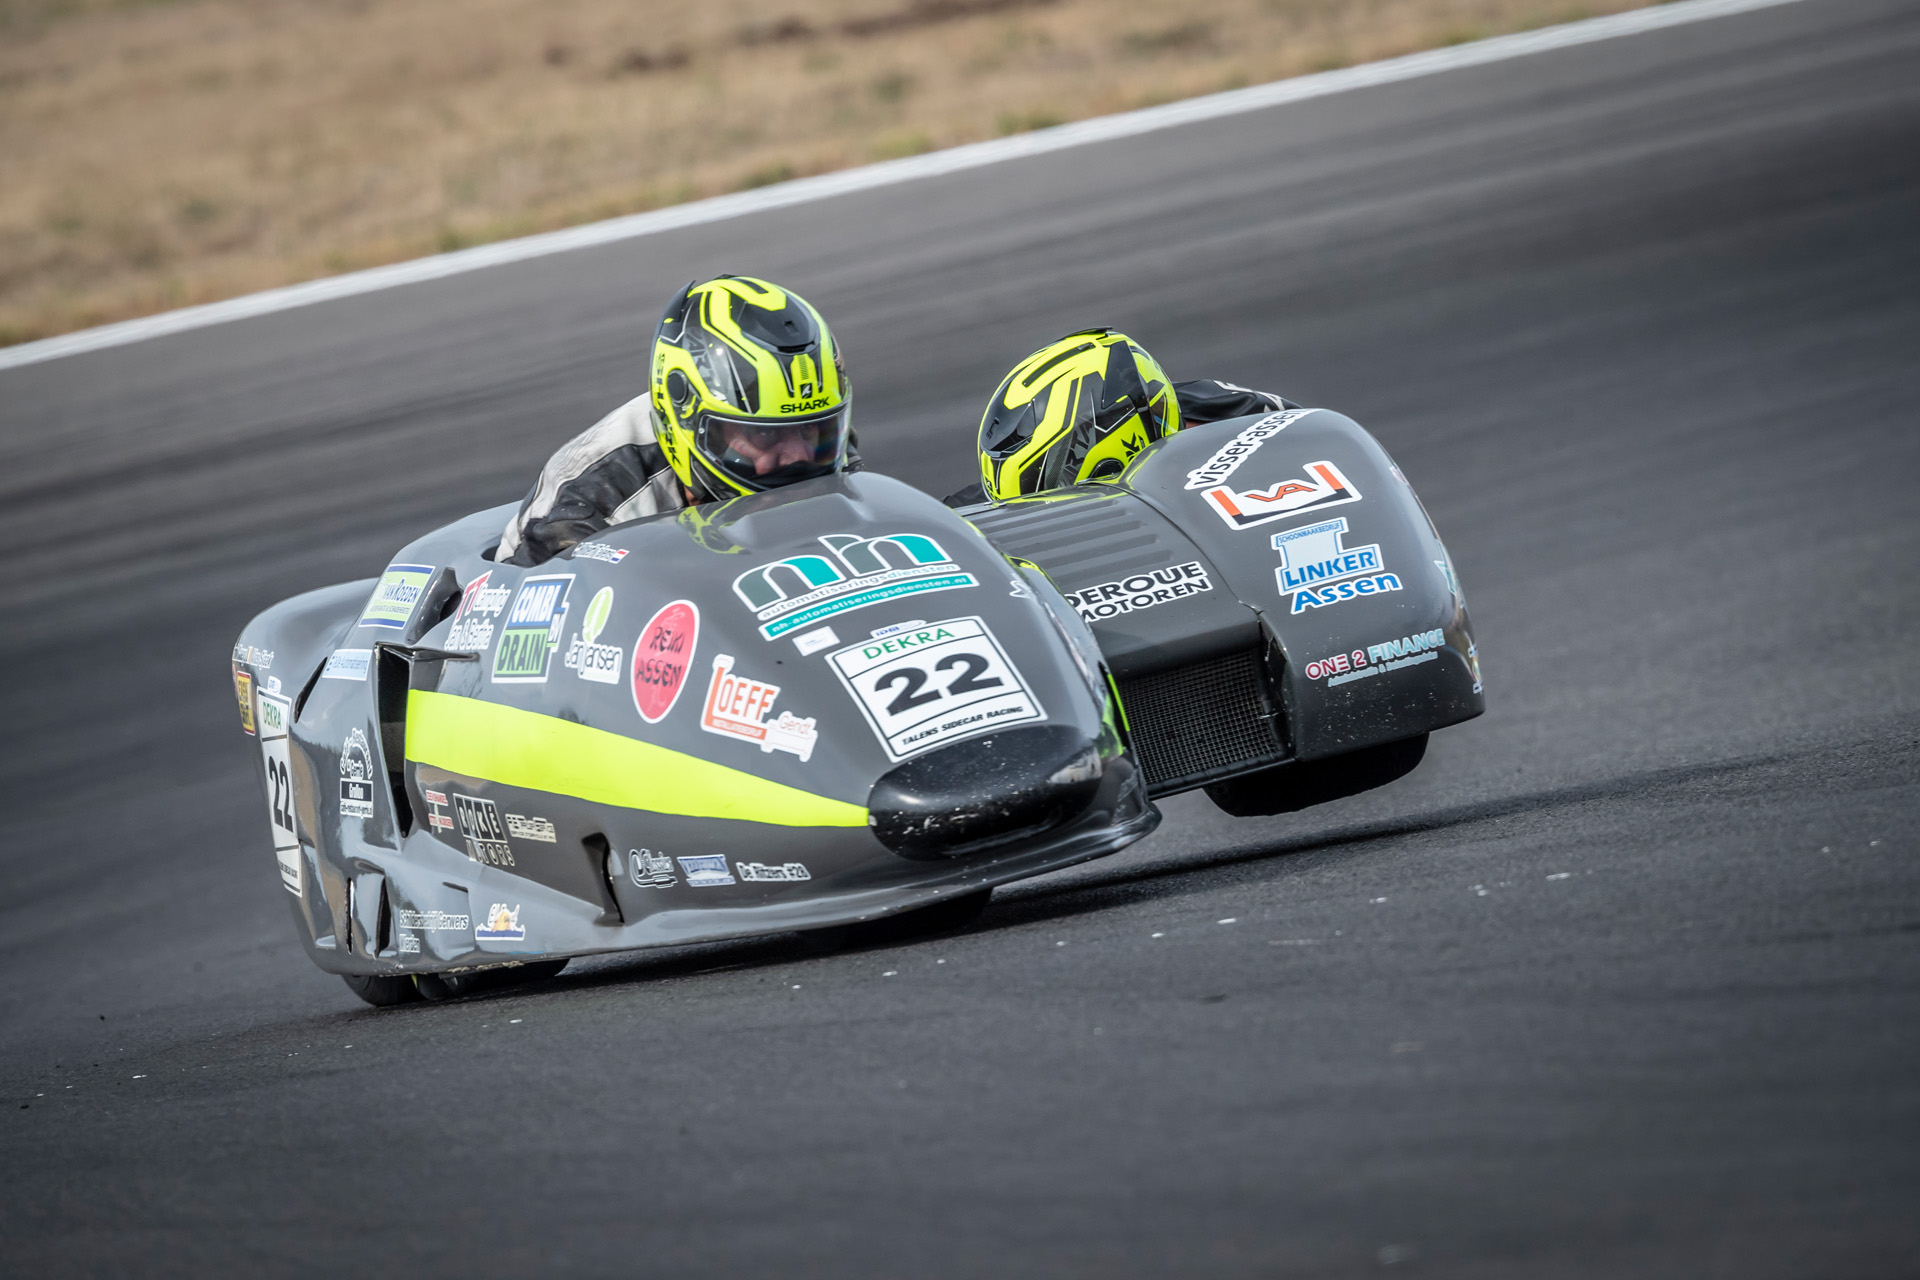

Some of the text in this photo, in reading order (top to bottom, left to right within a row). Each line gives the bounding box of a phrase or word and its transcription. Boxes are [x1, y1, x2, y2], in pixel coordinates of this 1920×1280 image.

[780, 396, 830, 414] SHARK
[1278, 522, 1341, 544] SCHOONMAAKBEDRIJF
[1284, 551, 1375, 587] LINKER
[456, 574, 490, 621] TT
[512, 585, 561, 623] COMBI
[761, 564, 957, 619] automatiseringsdiensten
[771, 577, 968, 633] nh-automatiseringsdiensten.nl
[1294, 574, 1400, 613] Assen
[497, 633, 547, 672] DRAIN
[649, 626, 686, 653] REIKI
[862, 628, 956, 660] DEKRA
[1306, 654, 1350, 679] ONE
[1352, 650, 1367, 668] 2
[1368, 629, 1446, 664] FINANCE
[635, 658, 682, 688] ASSEN
[874, 653, 1005, 717] 22
[262, 701, 282, 730] DEKRA
[704, 666, 775, 736] LOEFF
[902, 706, 1024, 746] TALENS SIDECAR RACING
[268, 755, 294, 833] 22
